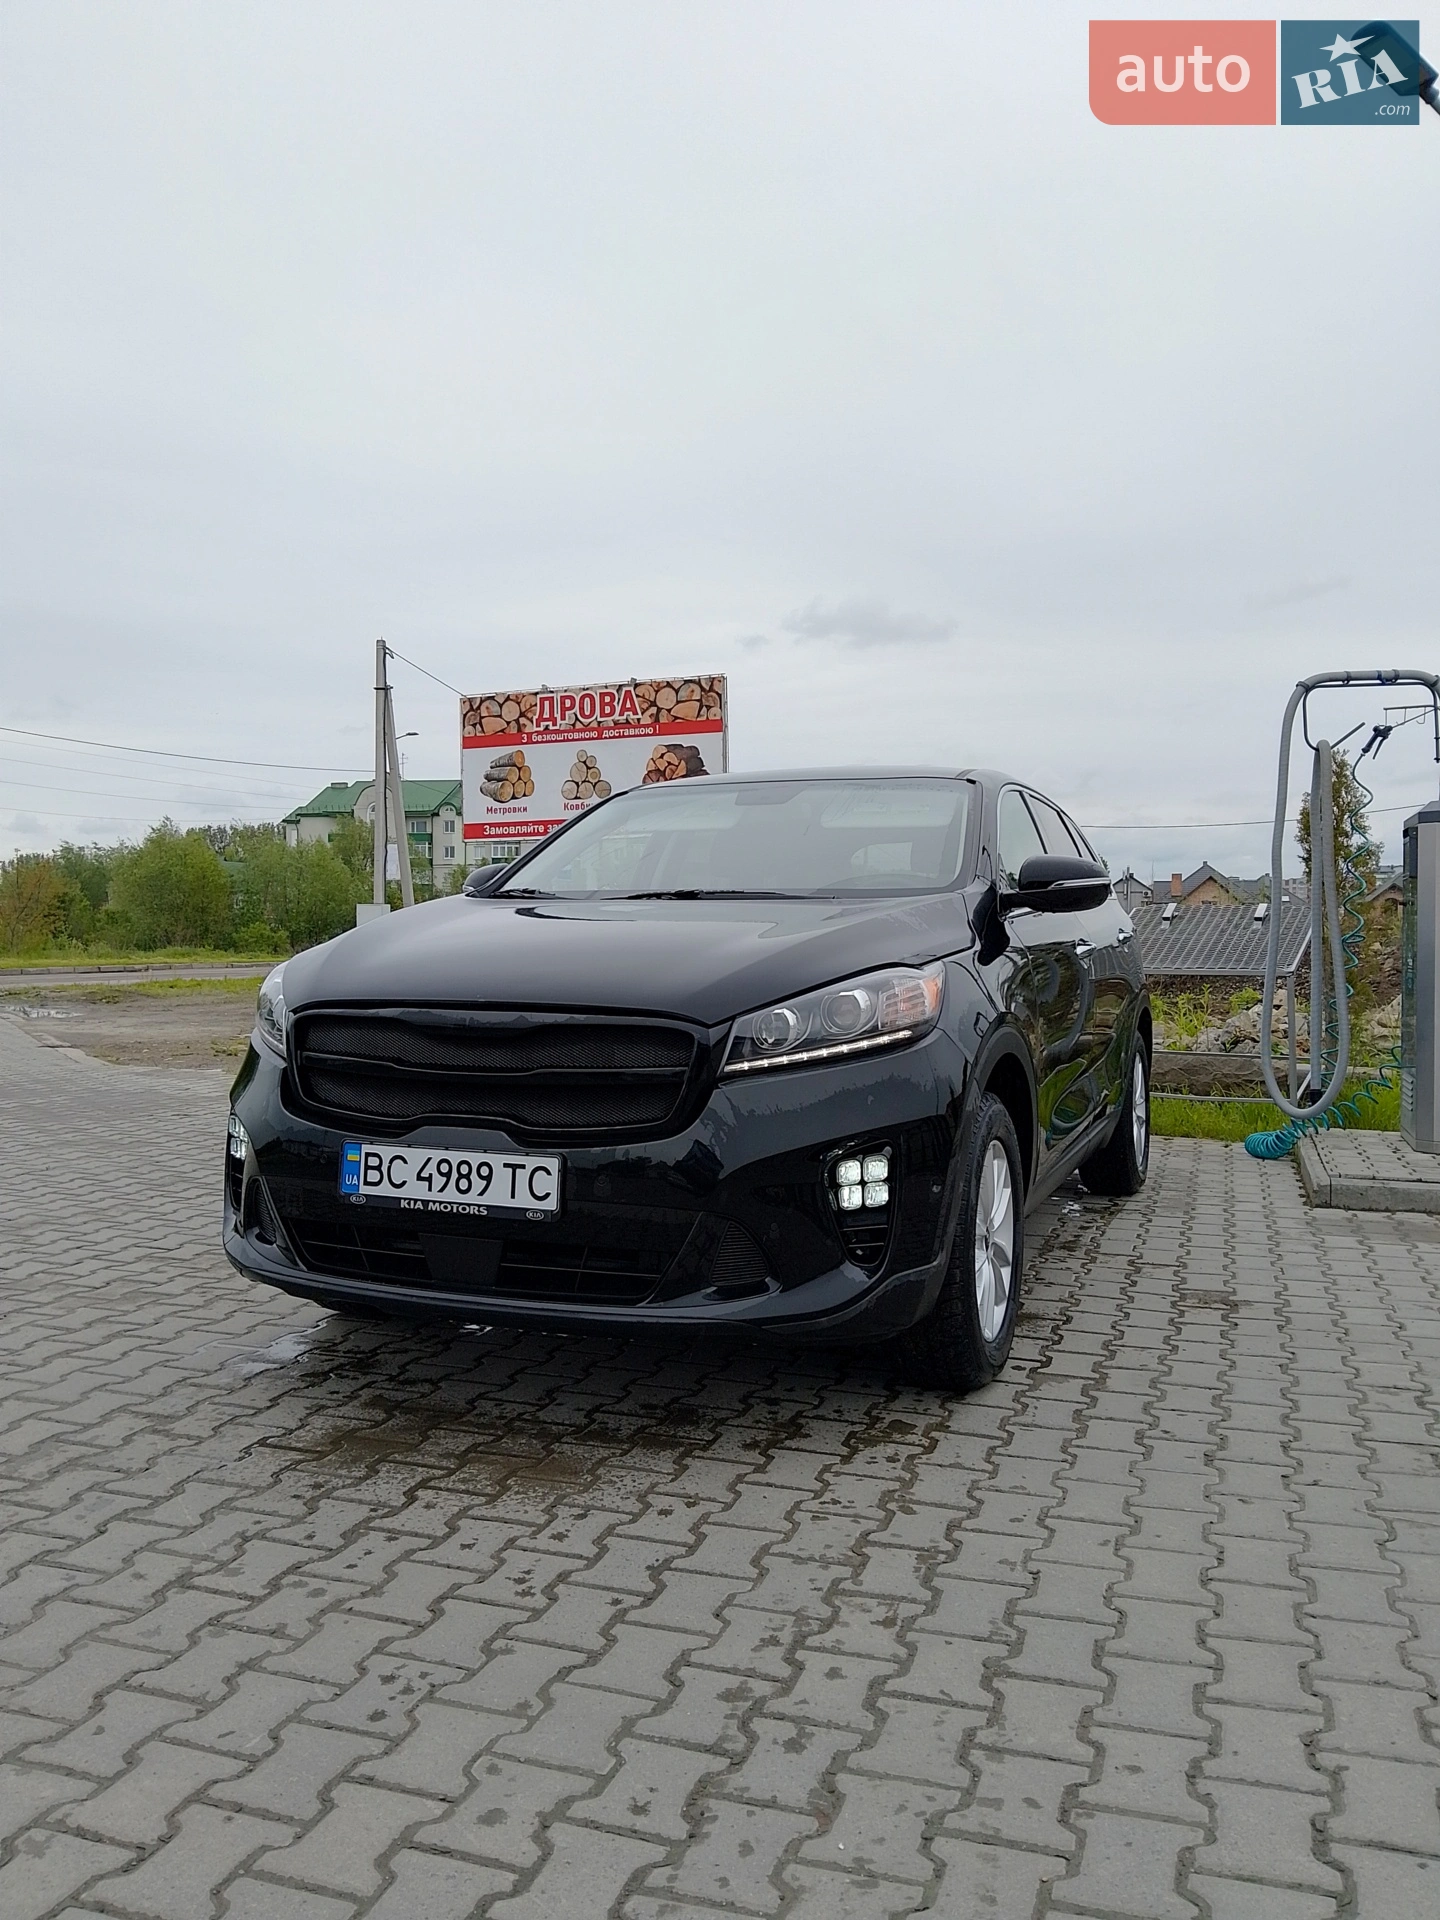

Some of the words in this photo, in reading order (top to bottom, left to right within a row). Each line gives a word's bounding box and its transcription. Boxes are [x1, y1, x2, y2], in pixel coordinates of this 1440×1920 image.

[536, 688, 640, 728] ДРОВА
[531, 729, 598, 742] безкоштовною
[602, 727, 653, 739] доставкою
[486, 806, 528, 815] Метровки
[483, 823, 544, 835] Замовляйте
[547, 824, 561, 833] за
[345, 1174, 359, 1186] UA
[362, 1151, 409, 1190] BC
[415, 1157, 494, 1197] 4989
[502, 1163, 553, 1202] TC
[351, 1195, 365, 1203] KIA
[400, 1199, 424, 1210] KIA
[428, 1202, 488, 1215] MOTORS
[527, 1211, 543, 1219] KIA
